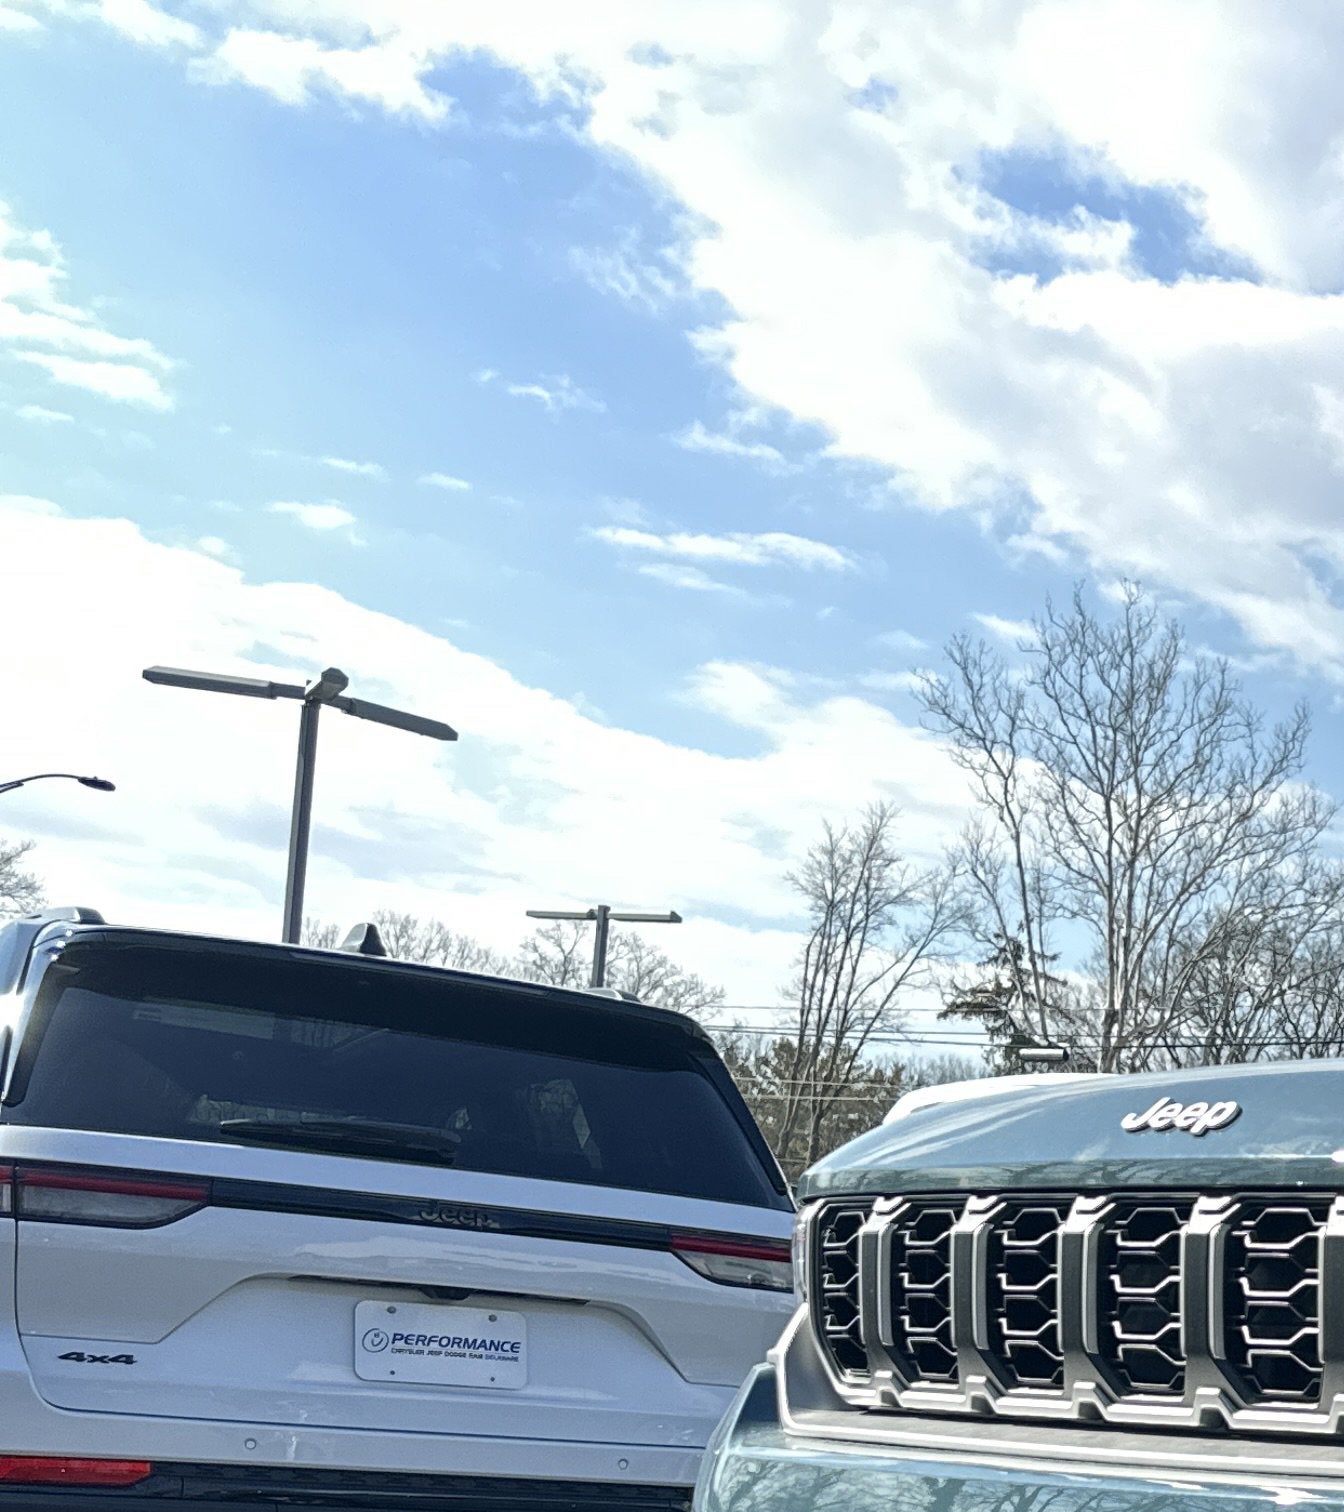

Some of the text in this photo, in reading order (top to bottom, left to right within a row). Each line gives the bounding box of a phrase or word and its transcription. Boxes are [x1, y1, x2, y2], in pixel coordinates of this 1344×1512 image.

[1120, 1097, 1242, 1136] Jeep
[418, 1201, 491, 1231] Jeep
[391, 1333, 521, 1353] PERFORMANCE
[57, 1352, 137, 1364] 4x4
